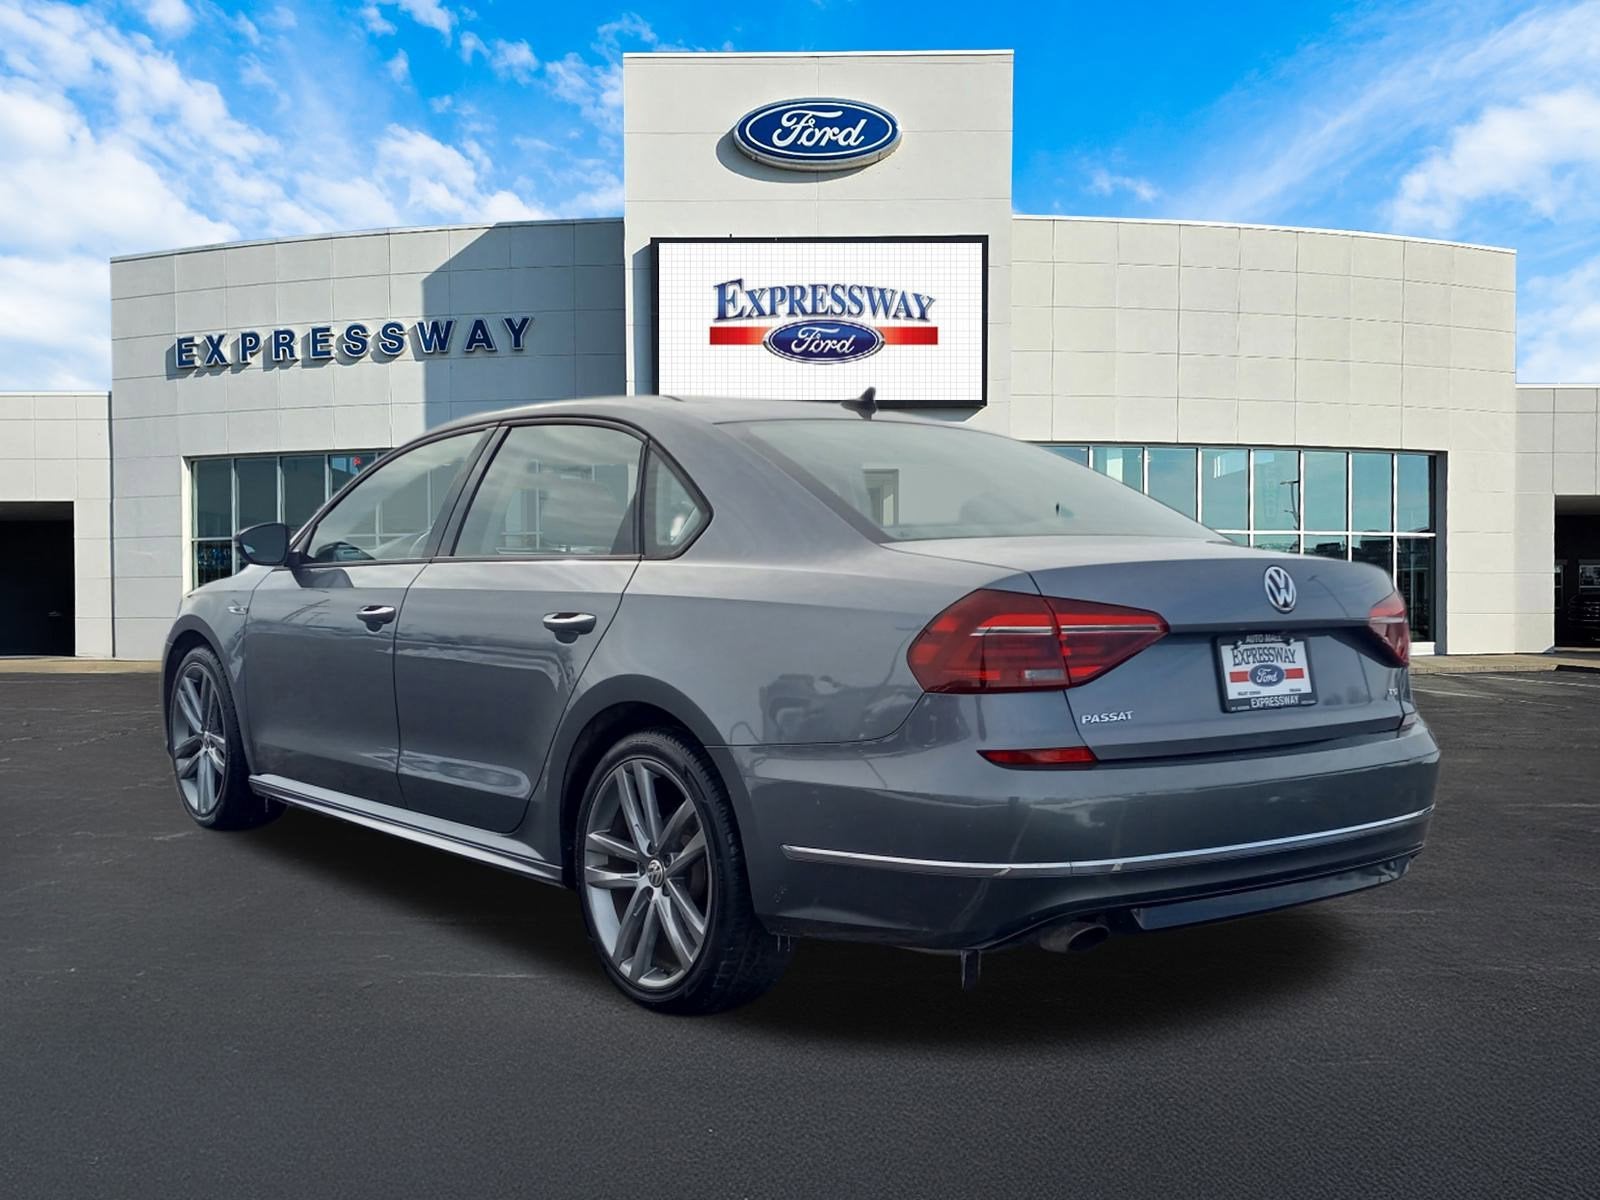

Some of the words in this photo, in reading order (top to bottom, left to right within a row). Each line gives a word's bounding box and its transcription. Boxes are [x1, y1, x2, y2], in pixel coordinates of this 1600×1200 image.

[771, 109, 865, 147] Ford
[175, 316, 533, 369] EXPRESSWAY
[790, 326, 857, 355] Ford
[1246, 634, 1264, 643] AUTO
[1265, 634, 1282, 642] MALL
[1231, 646, 1297, 666] EXPRESSWAY
[1256, 667, 1278, 683] Ford
[1251, 695, 1300, 708] EXPRESSWAY
[1081, 710, 1134, 724] PASSAT
